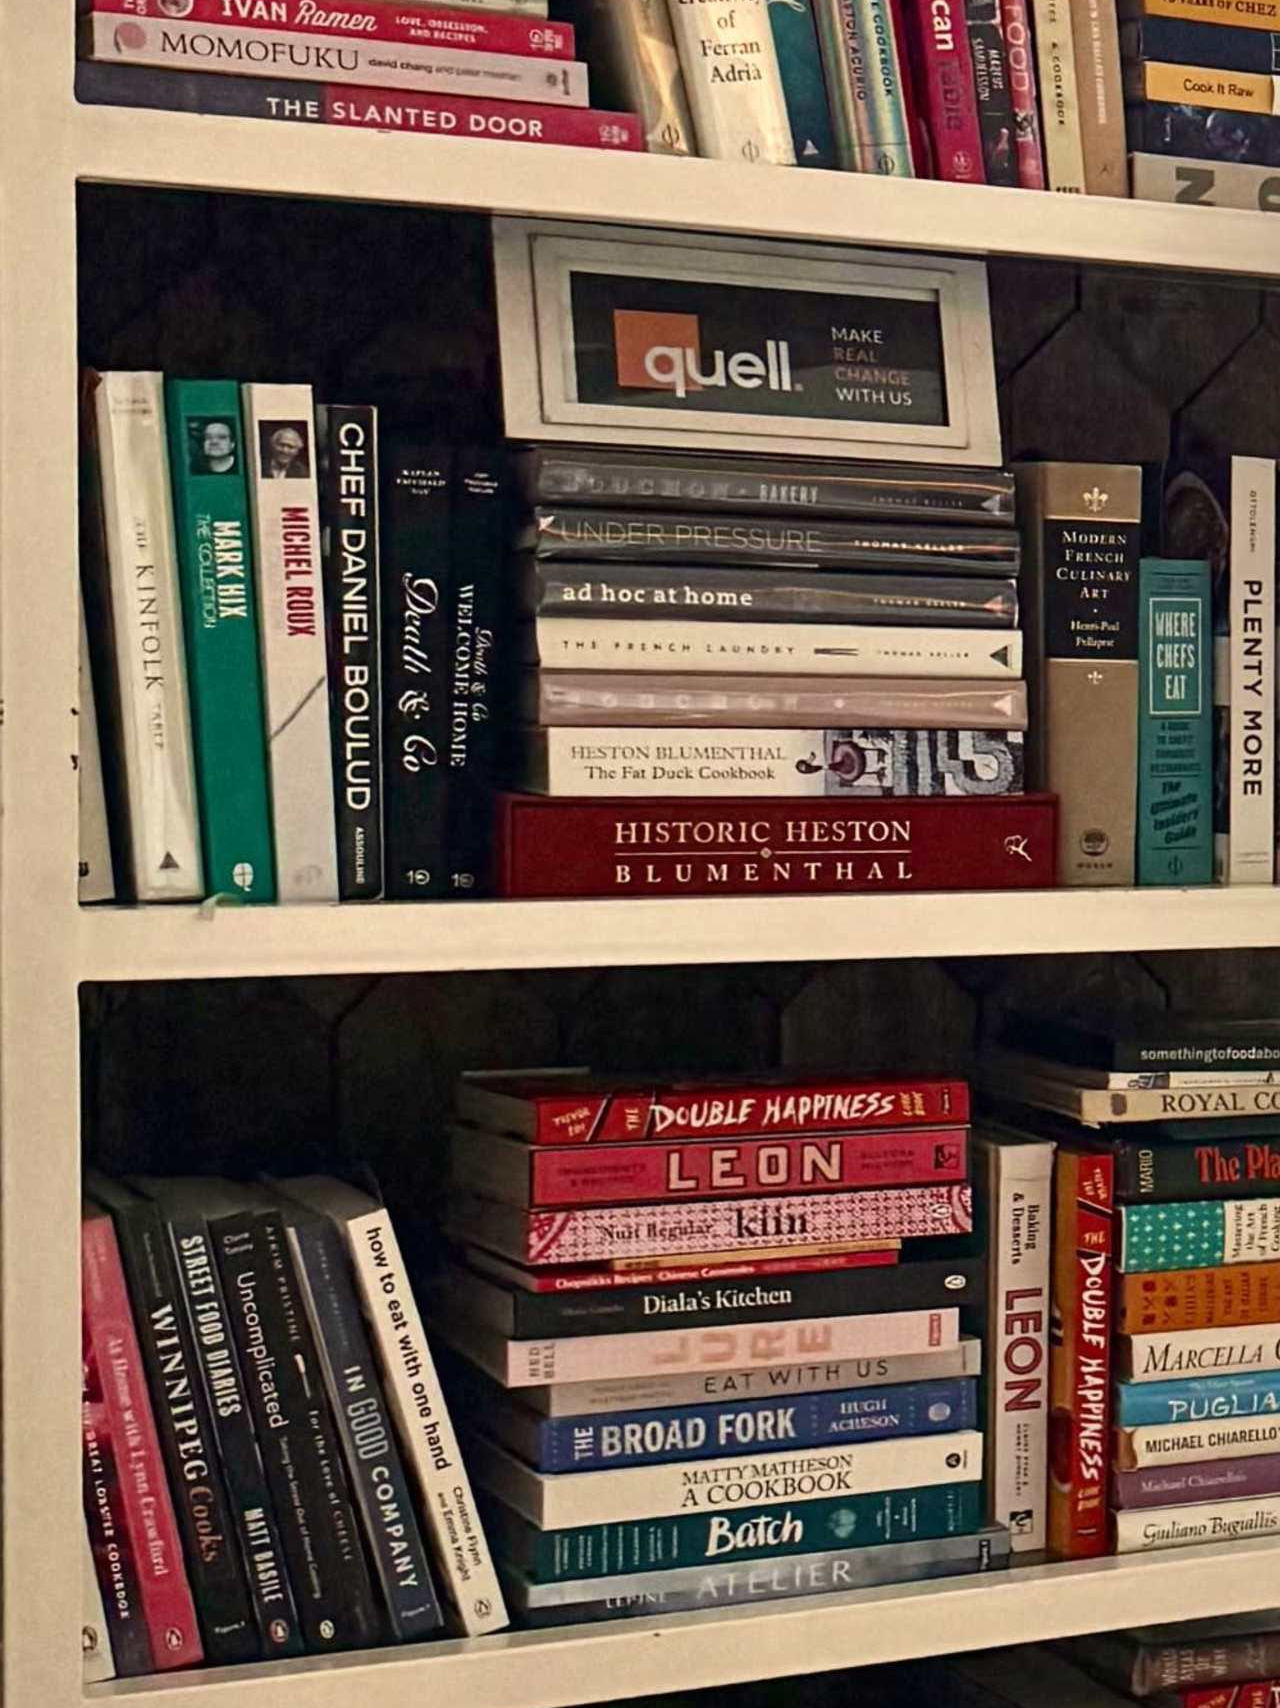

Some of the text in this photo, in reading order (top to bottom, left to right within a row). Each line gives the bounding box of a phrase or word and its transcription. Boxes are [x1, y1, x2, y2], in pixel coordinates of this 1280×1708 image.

[294, 0, 377, 32] Ramen
[717, 10, 736, 29] of
[1217, 0, 1233, 10] OF
[1235, 0, 1277, 18] CHEZ
[160, 31, 360, 72] MOMOFUKU
[699, 38, 761, 58] Ferran
[709, 65, 762, 83] Adrià
[266, 97, 543, 137] THE SLANTED DOOR
[831, 326, 883, 344] MAKE
[834, 346, 878, 364] REAL
[834, 366, 910, 387] CHANGE
[835, 387, 912, 407] WITH US
[560, 518, 825, 554] UNDER PRESSURE
[1062, 530, 1127, 545] MODERN
[212, 520, 248, 619] MARK HIX
[1065, 549, 1125, 563] FRENCH
[281, 507, 317, 638] MICHEL ROUX
[1056, 566, 1131, 582] CULINARY
[562, 584, 753, 608] ad hoc at home
[1080, 587, 1109, 599] ART
[338, 422, 372, 812] CHEF DANIEL BOULUD
[1155, 612, 1197, 637] WHERE
[1156, 644, 1196, 669] CHEFS
[1165, 675, 1187, 700] EAT
[1243, 580, 1263, 796] PLENTY MORE
[570, 745, 788, 763] HESTON BLUMENTHAL
[584, 764, 776, 782] The Fat Duck Cookbook
[614, 818, 912, 846] HISTORIC HESTON
[615, 861, 914, 884] BLUMENTHAL
[651, 1092, 897, 1134] DOUBLE HAPPINESS
[1159, 1090, 1245, 1114] ROYAL
[666, 1143, 843, 1192] LEON
[1139, 1149, 1153, 1194] MARIO
[1195, 1146, 1242, 1184] The
[236, 1272, 290, 1430] Uncomplicated
[366, 1227, 453, 1472] how to eat with one hand
[1004, 1287, 1043, 1414] LEON
[1142, 1340, 1265, 1374] MARCELLA
[703, 1359, 892, 1395] EAT WITH US
[839, 1399, 888, 1415] HUGH
[1167, 1391, 1280, 1421] PUGLIA
[573, 1407, 797, 1461] THE BROAD FORK
[1144, 1432, 1205, 1454] MICHAEL
[681, 1454, 854, 1488] MATTY MATHESON
[680, 1470, 853, 1508] A COOKBOOK
[704, 1512, 804, 1560] Batch
